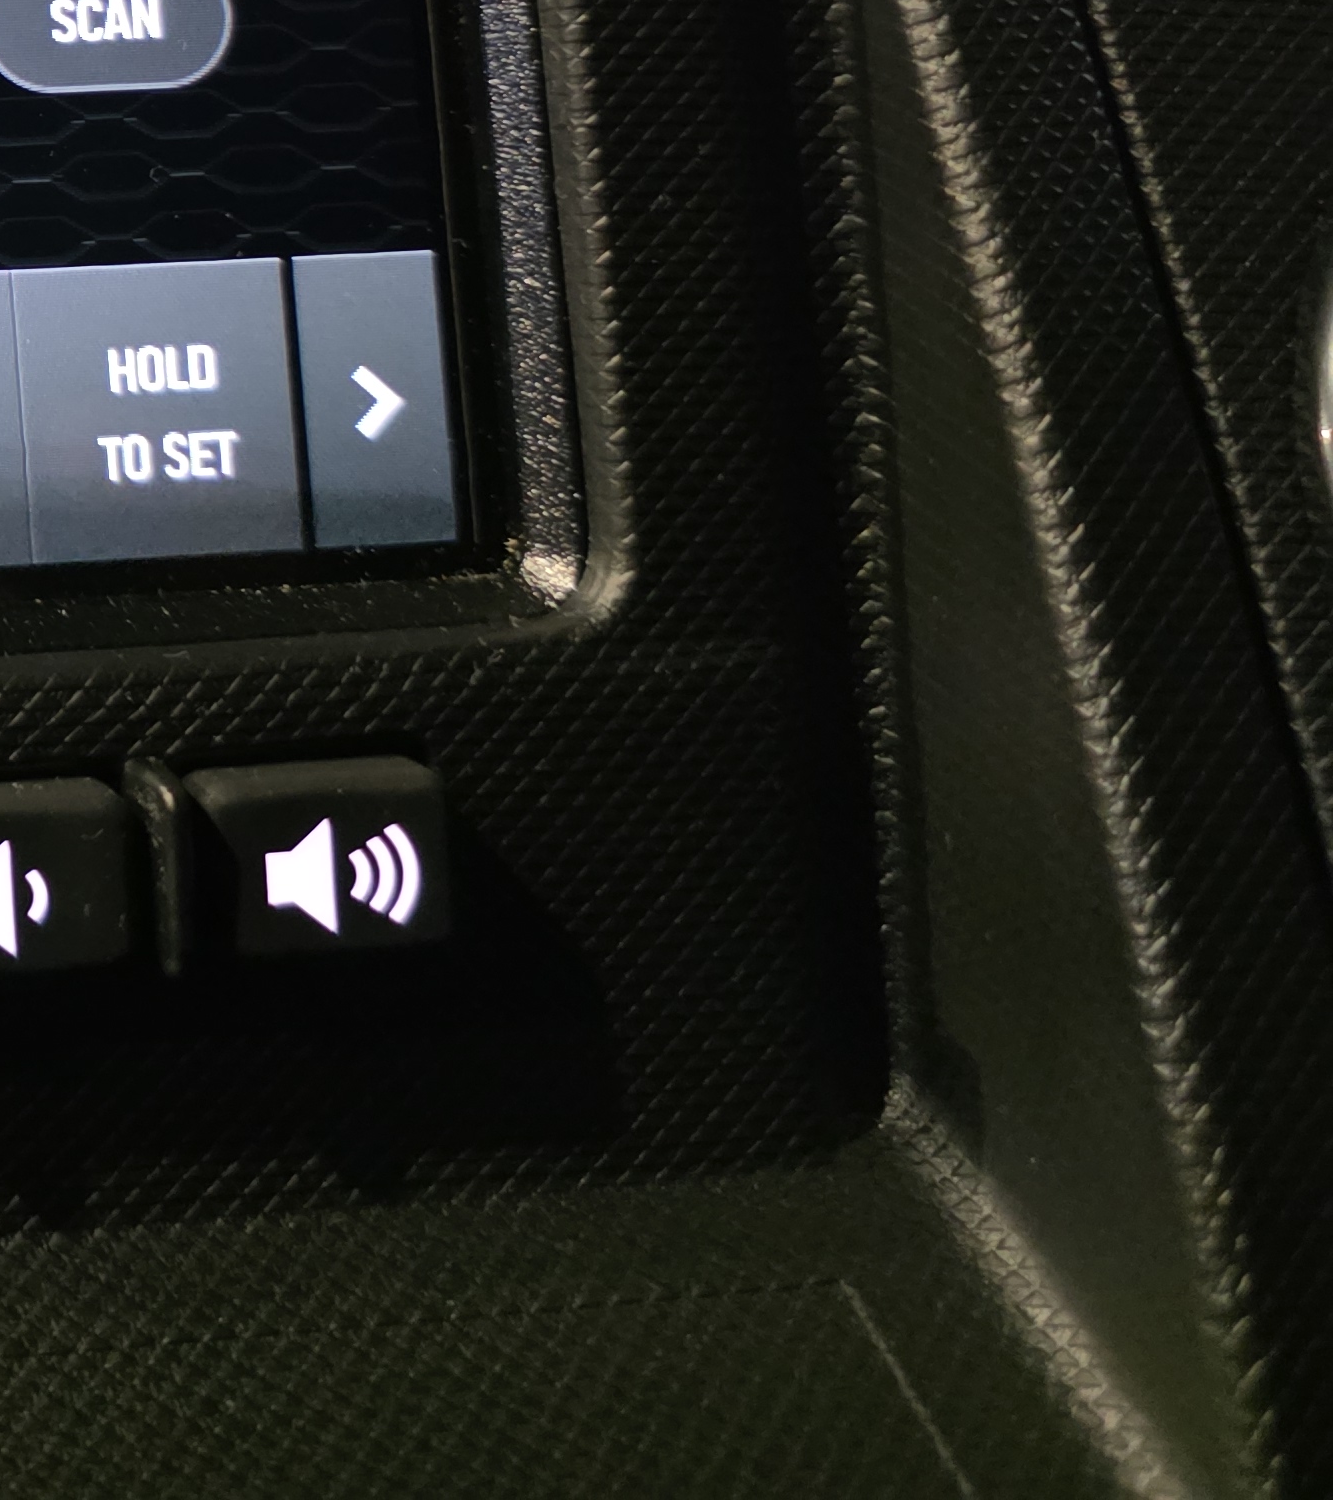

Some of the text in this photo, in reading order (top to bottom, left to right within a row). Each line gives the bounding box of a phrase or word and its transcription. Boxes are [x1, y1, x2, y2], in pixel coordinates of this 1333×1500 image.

[106, 343, 220, 395] HOLD
[96, 429, 240, 484] TO SET
